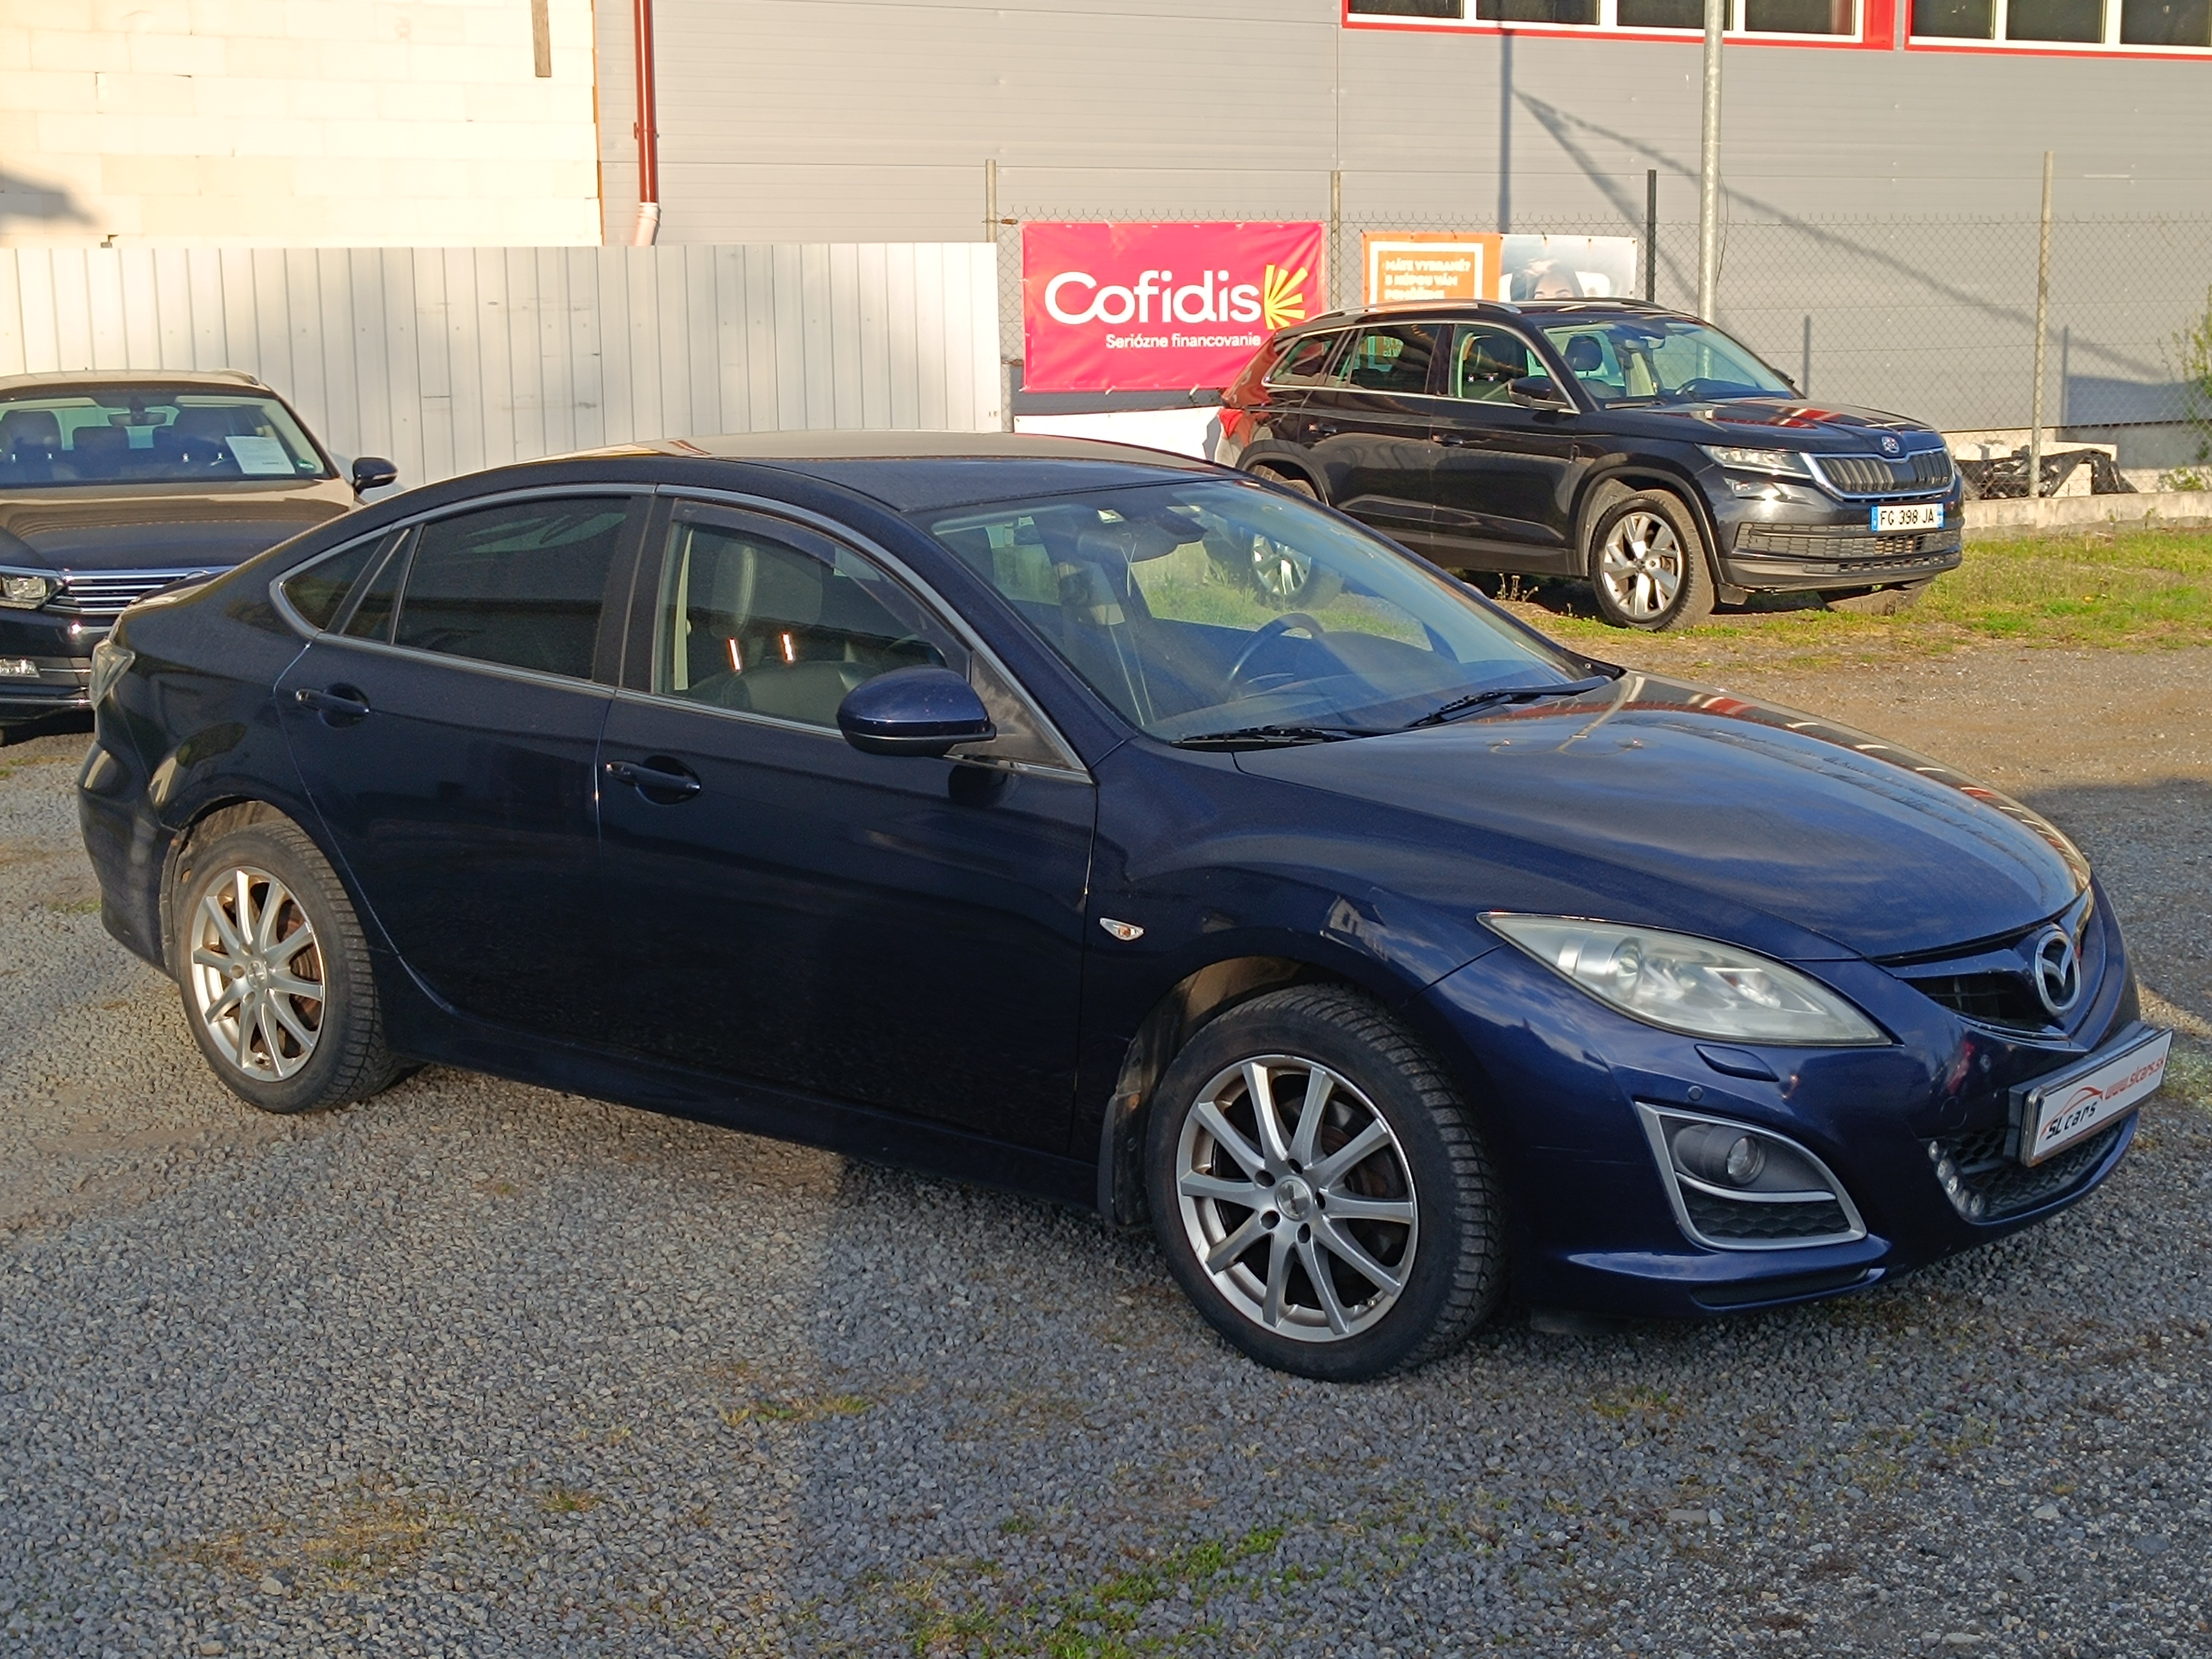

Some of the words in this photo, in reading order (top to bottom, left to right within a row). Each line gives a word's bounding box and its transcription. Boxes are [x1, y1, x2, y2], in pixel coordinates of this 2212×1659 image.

[1044, 270, 1262, 325] Cofidis
[1106, 333, 1168, 348] Seriózne
[1171, 332, 1261, 348] financovanie
[1880, 510, 1894, 525] FG
[1898, 509, 1918, 525] 398
[1922, 508, 1934, 523] JA
[2064, 1102, 2098, 1130] cars
